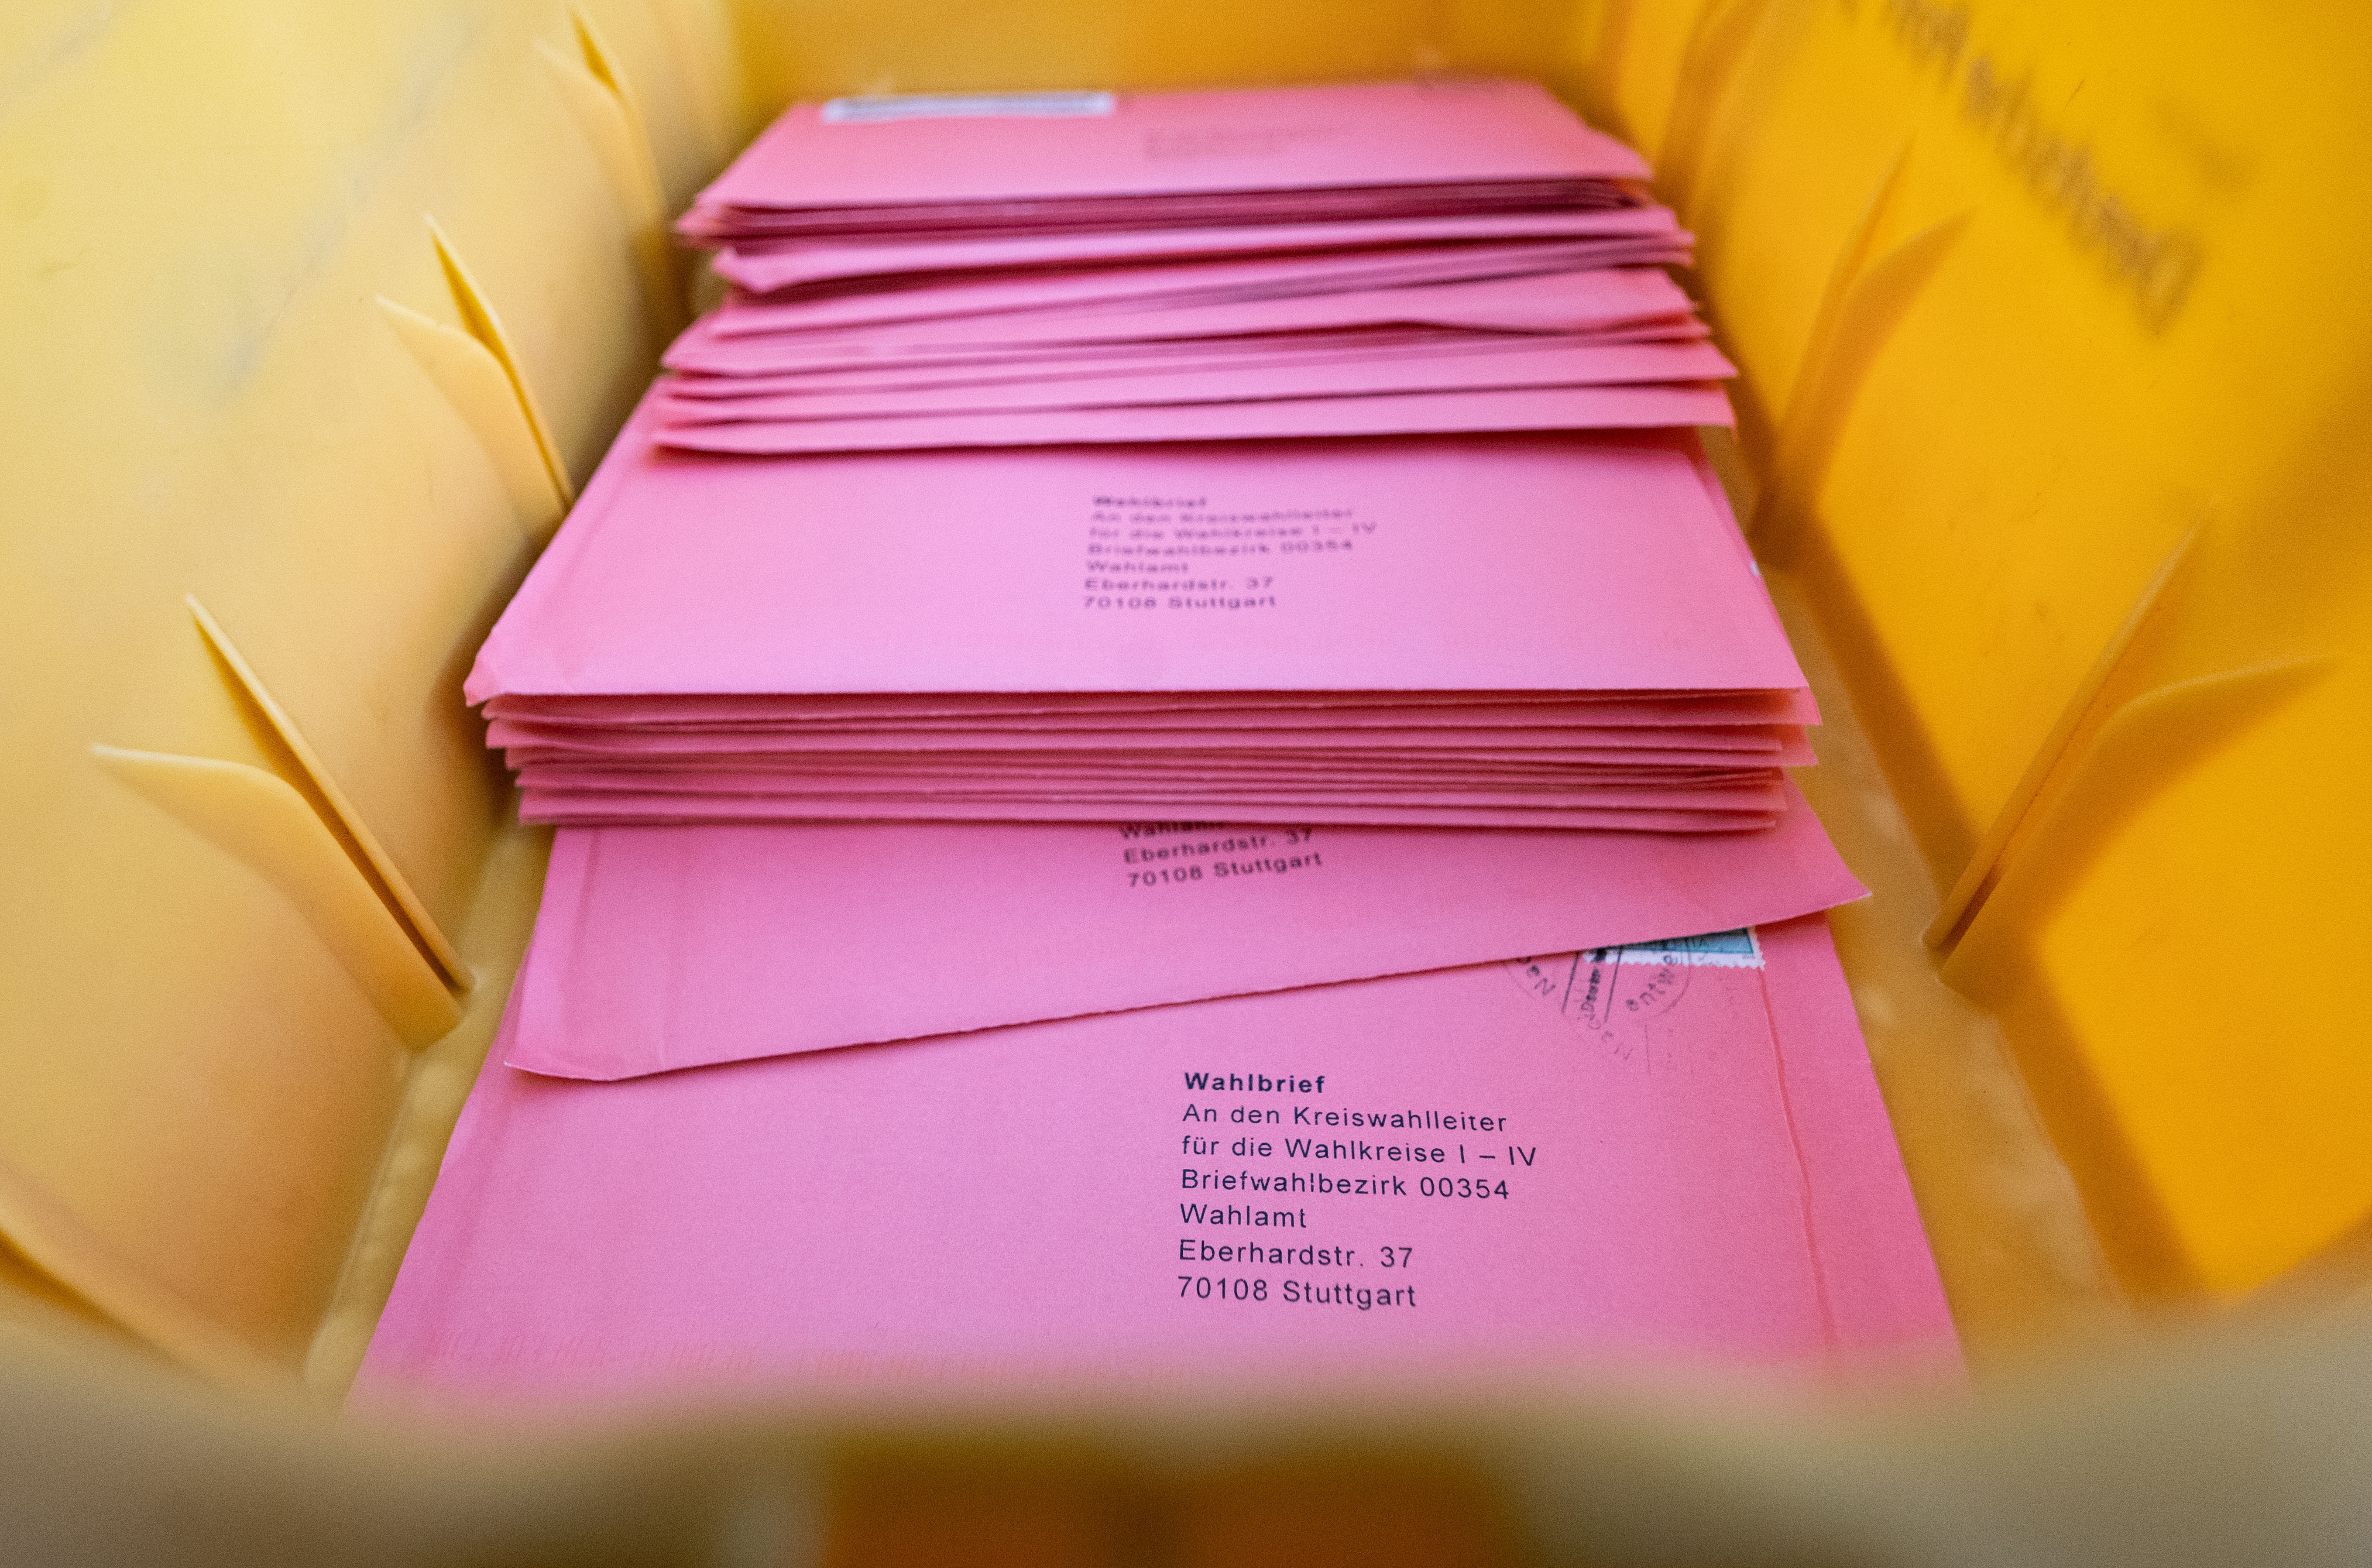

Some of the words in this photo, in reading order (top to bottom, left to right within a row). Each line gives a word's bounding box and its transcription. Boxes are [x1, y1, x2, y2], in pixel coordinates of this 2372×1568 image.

[1248, 576, 1273, 589] 37
[1085, 596, 1157, 608] 70108
[1169, 596, 1275, 610] Stuttgart
[1286, 827, 1312, 845] 37
[1127, 865, 1203, 888] 70108
[1213, 852, 1321, 877] Stuttgart
[1185, 1073, 1325, 1093] Wahlbrief
[1183, 1104, 1216, 1122] An
[1231, 1106, 1279, 1124] den
[1294, 1107, 1506, 1131] Kreiswahlleiter
[1183, 1136, 1219, 1155] für
[1232, 1137, 1272, 1156] die
[1285, 1139, 1445, 1163] Wahlkreise
[1460, 1145, 1465, 1163] I
[1509, 1146, 1536, 1166] IV
[1182, 1169, 1406, 1195] Briefwahlbezirk
[1421, 1177, 1508, 1199] 00354
[1181, 1204, 1306, 1228] Wahlamt
[1180, 1239, 1363, 1266] Eberhardstr.
[1381, 1246, 1412, 1268] 37
[1178, 1276, 1267, 1301] 70108
[1284, 1280, 1415, 1311] Stuttgart
